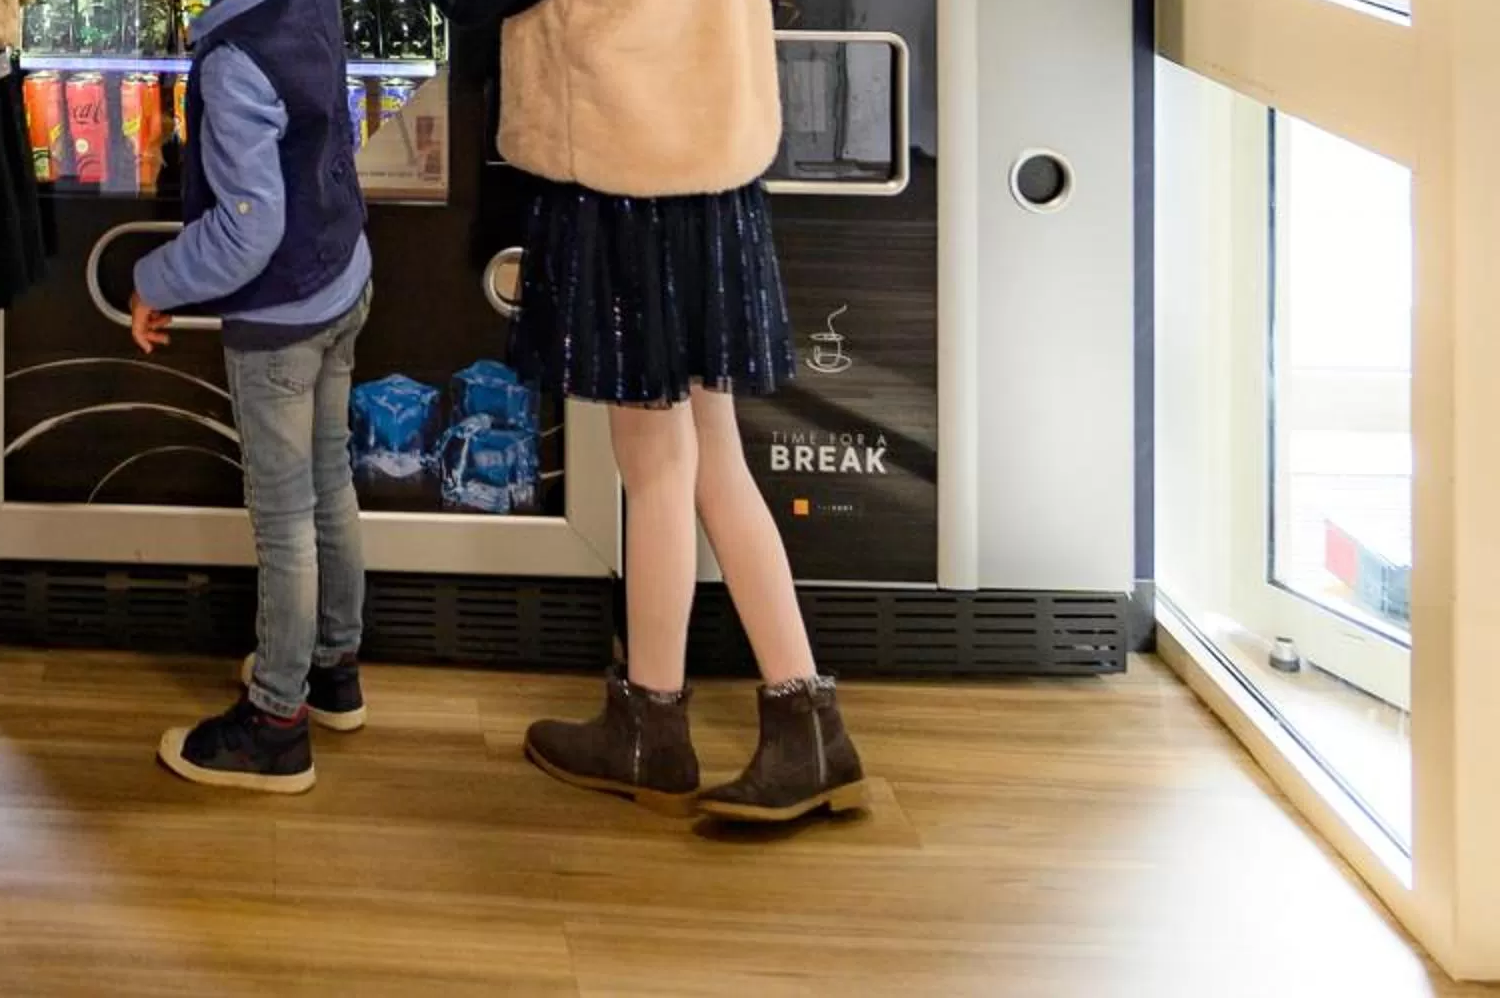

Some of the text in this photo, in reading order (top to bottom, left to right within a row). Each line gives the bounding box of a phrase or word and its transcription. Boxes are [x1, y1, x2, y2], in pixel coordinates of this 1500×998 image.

[771, 430, 888, 447] TIME FOR A
[771, 445, 887, 474] BREAK
